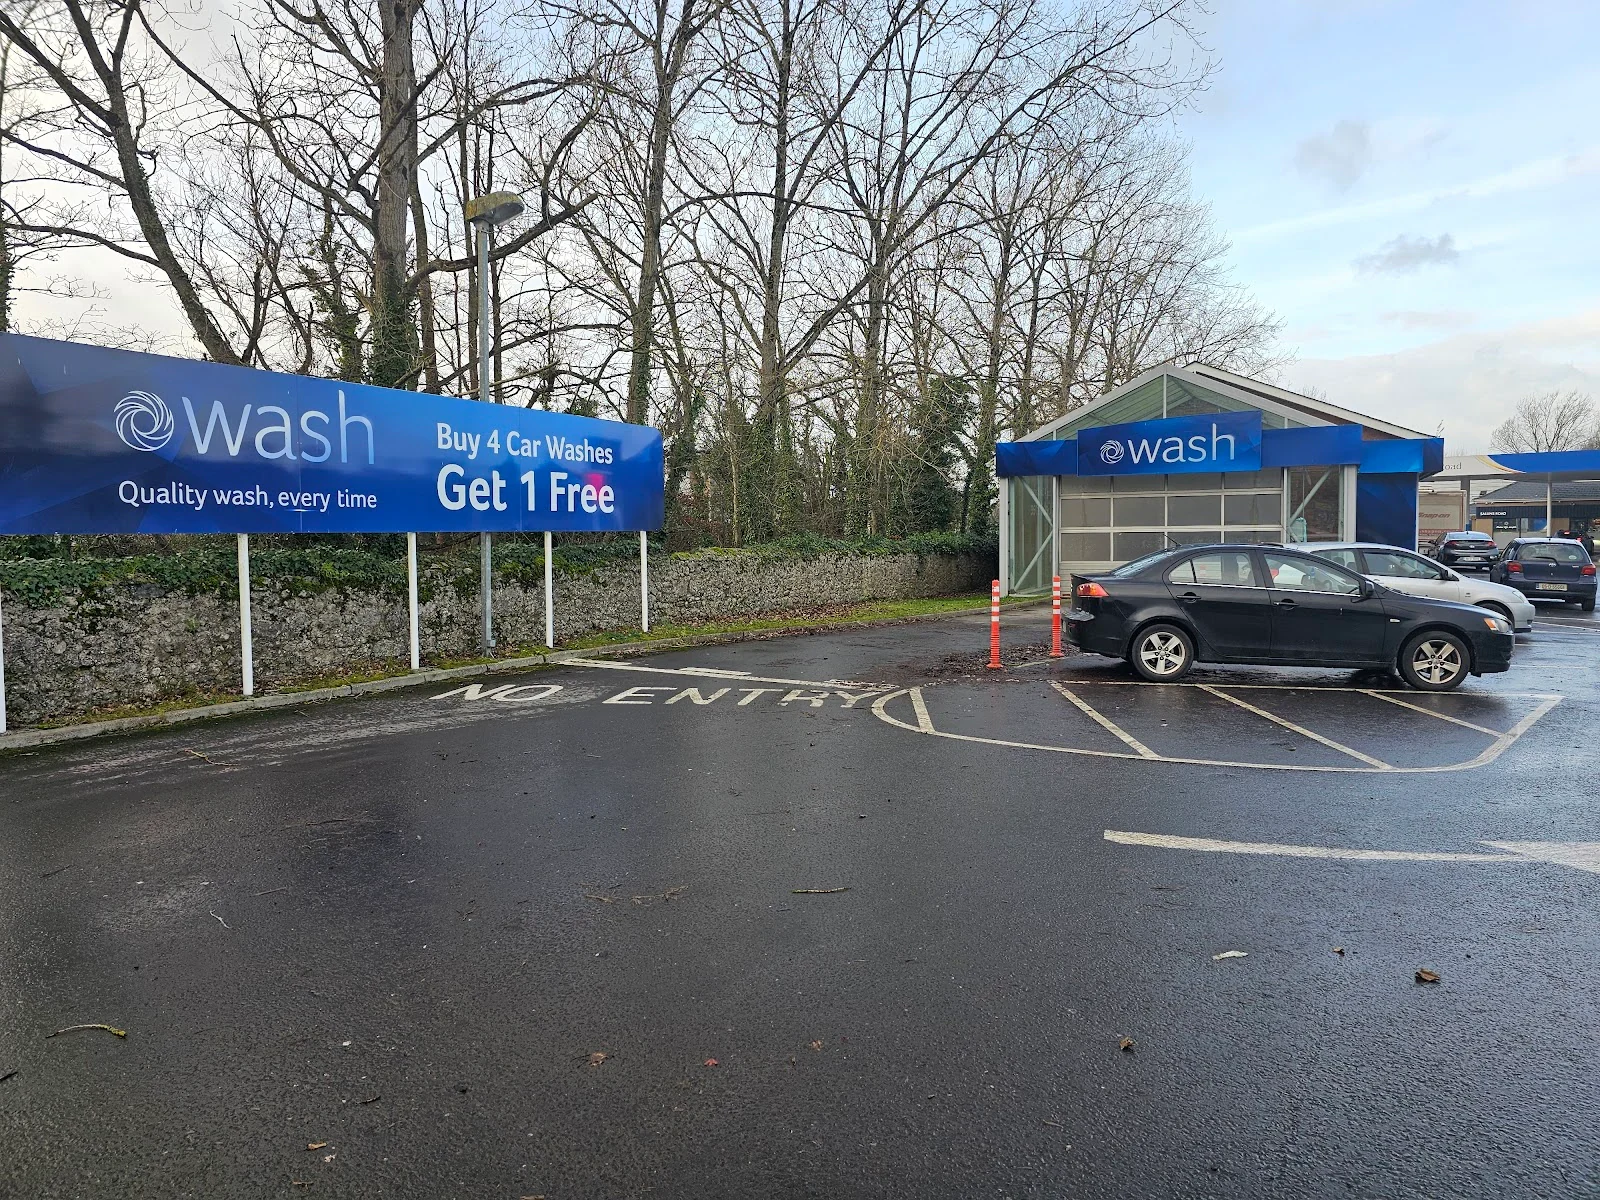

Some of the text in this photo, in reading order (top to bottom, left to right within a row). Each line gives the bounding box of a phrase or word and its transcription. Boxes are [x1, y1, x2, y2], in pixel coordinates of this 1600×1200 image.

[181, 389, 375, 465] wash
[436, 422, 613, 465] Buy 4 Car Washes
[1127, 422, 1235, 464] wash
[1444, 462, 1462, 471] oad
[118, 480, 377, 512] Quality wash, every time
[437, 463, 615, 514] Get 1 Free
[428, 683, 883, 708] NO ENTRY
